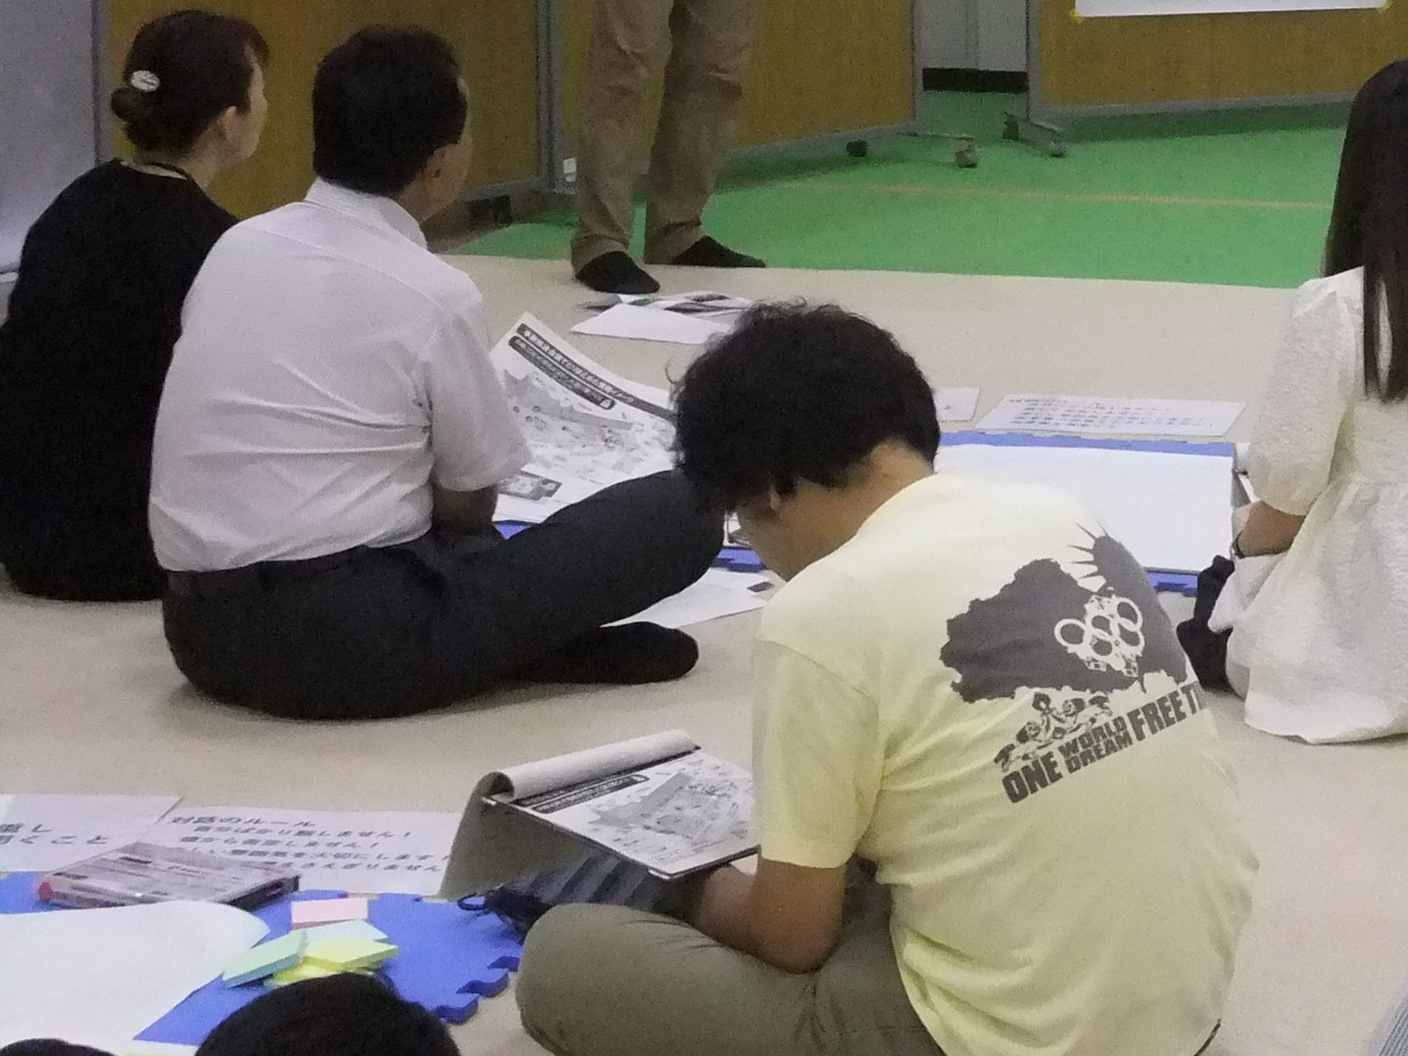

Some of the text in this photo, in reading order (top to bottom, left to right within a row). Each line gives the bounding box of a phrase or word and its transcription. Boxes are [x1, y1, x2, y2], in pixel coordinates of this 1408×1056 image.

[1058, 711, 1128, 759] WORLD
[1064, 732, 1134, 775] DREAM
[1001, 751, 1064, 804] ONE
